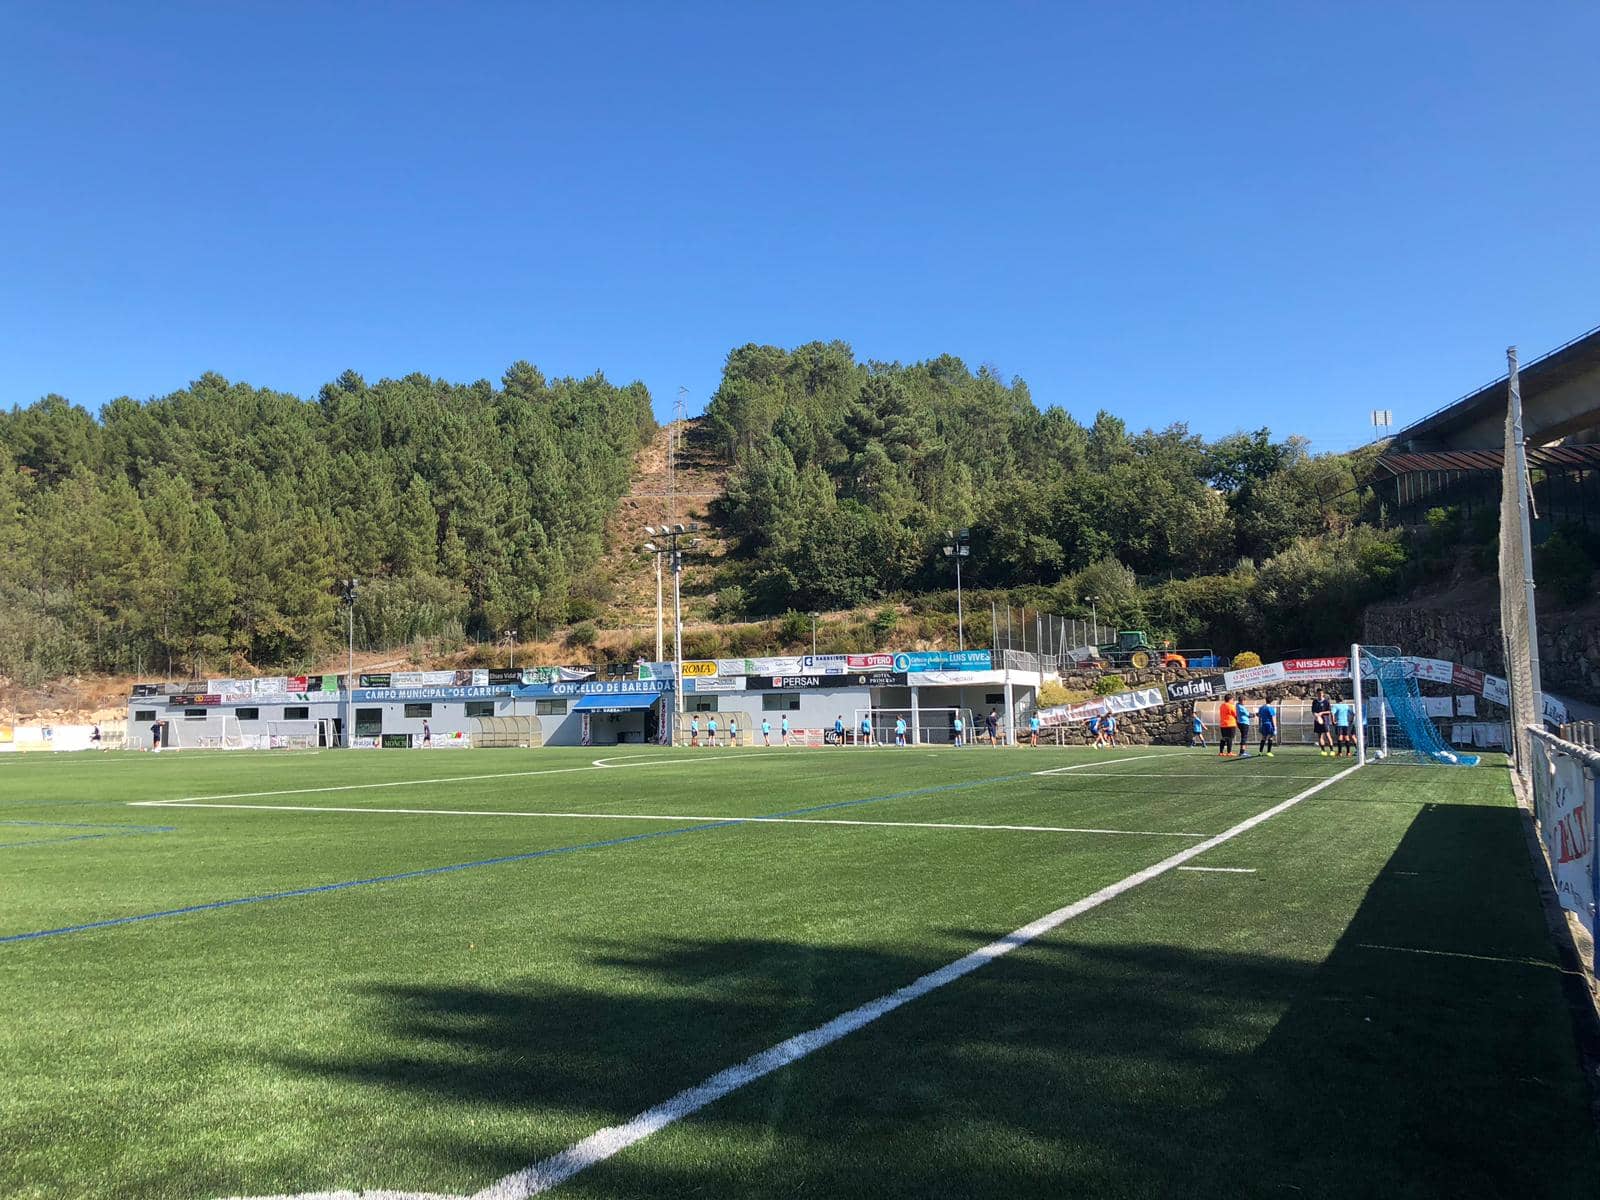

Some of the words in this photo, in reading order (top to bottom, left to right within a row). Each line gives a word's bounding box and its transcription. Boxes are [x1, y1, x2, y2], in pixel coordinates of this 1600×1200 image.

[867, 656, 891, 664] OTERO
[949, 653, 967, 662] LUIS
[967, 652, 991, 661] VIVES
[1296, 659, 1335, 668] NISSAN
[682, 664, 711, 673] ROMA
[783, 677, 819, 686] PERSAN
[552, 683, 603, 694] CONCELLO
[606, 683, 618, 692] DE
[365, 690, 396, 699] CAMPO
[398, 688, 446, 698] MUNICIPAL
